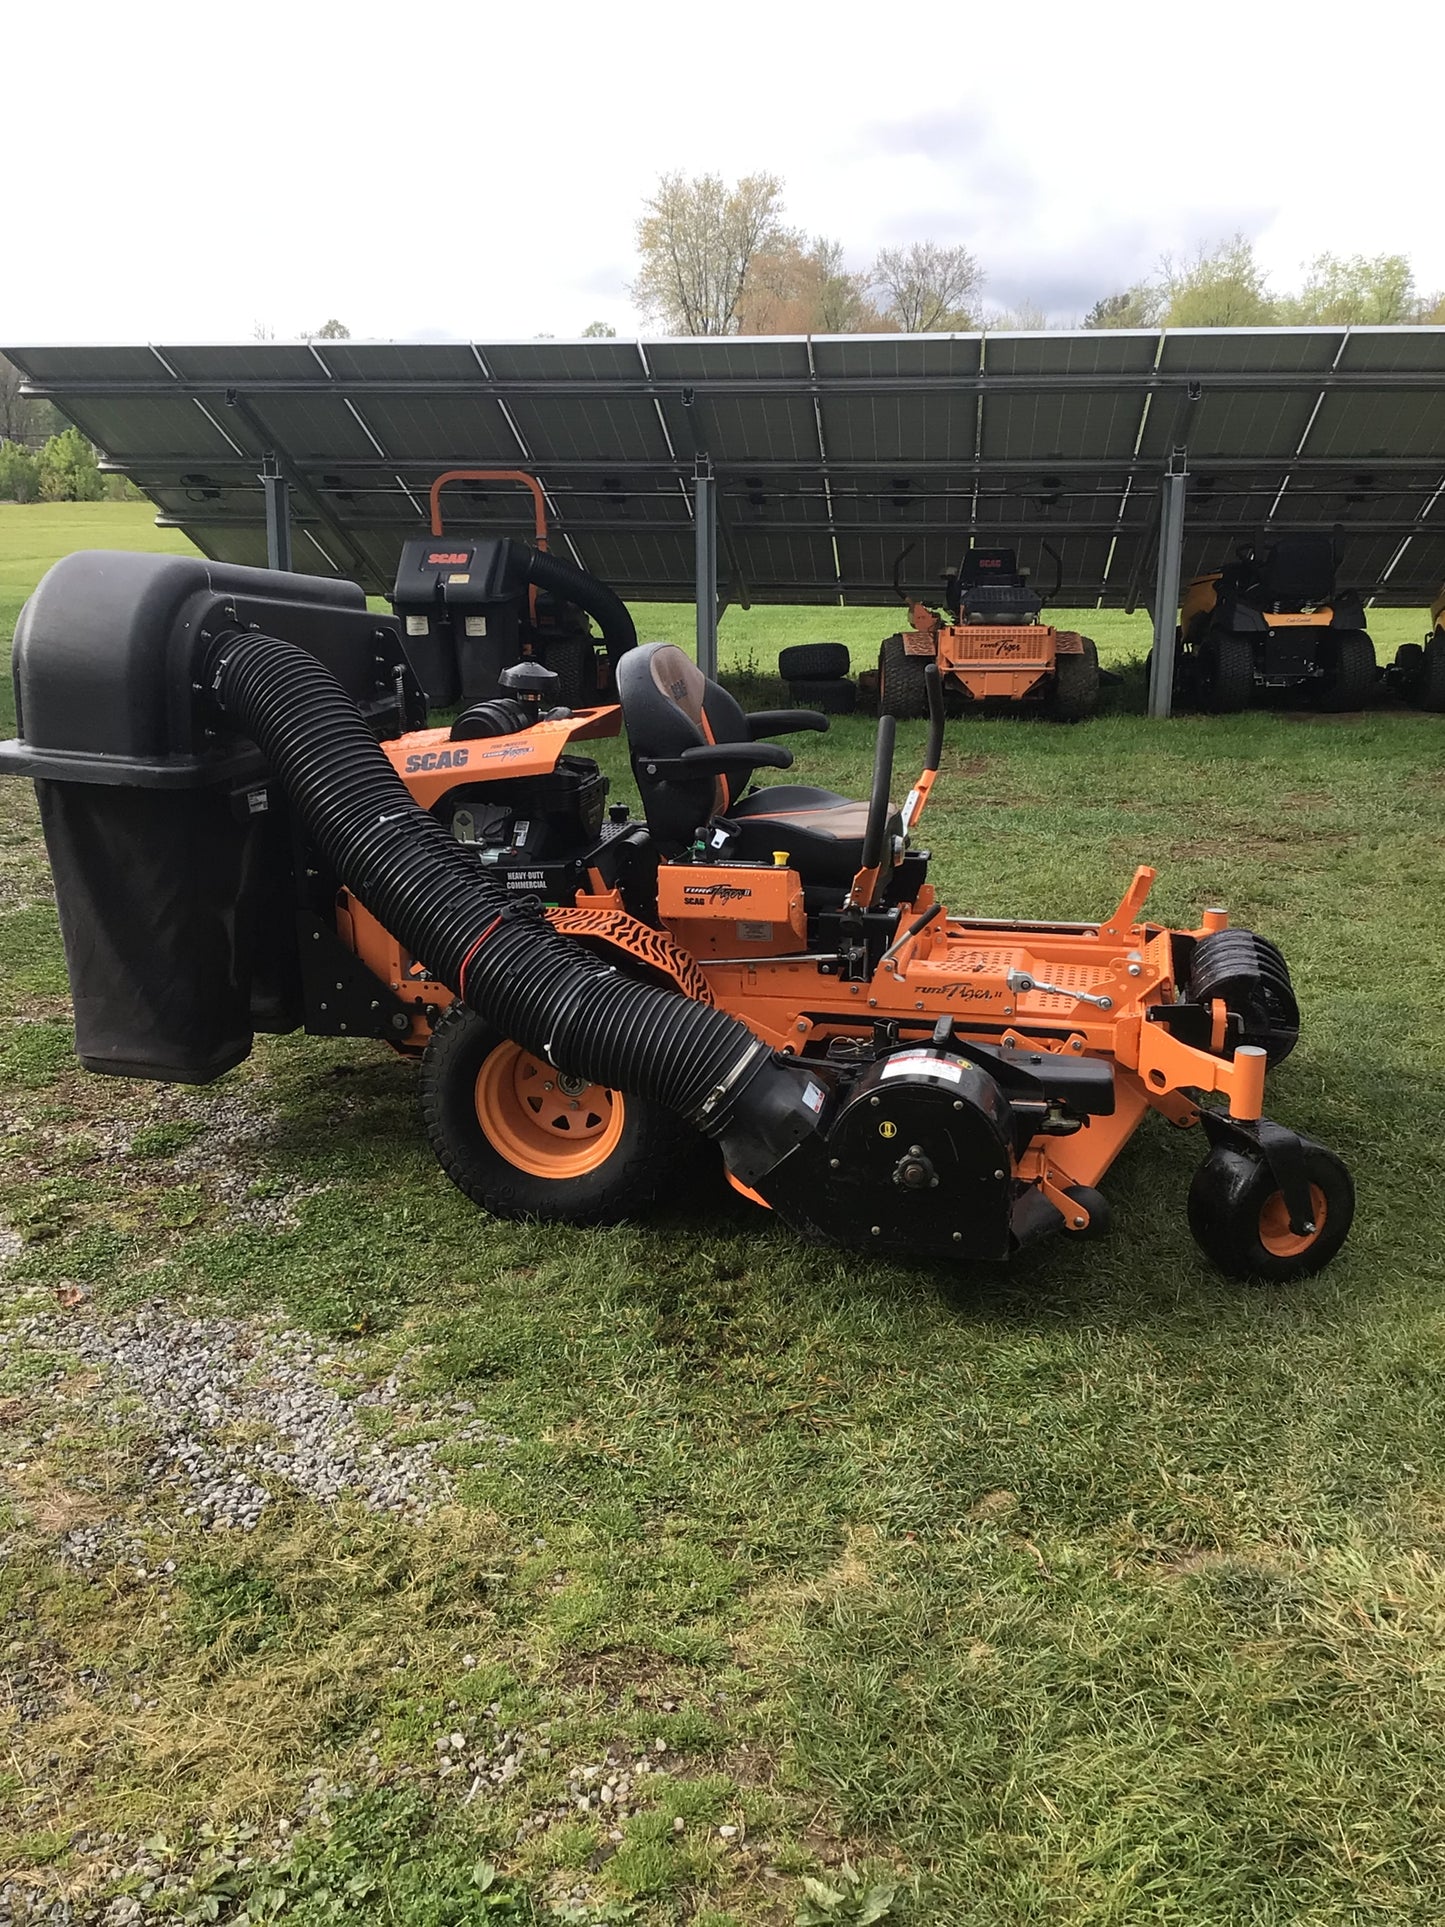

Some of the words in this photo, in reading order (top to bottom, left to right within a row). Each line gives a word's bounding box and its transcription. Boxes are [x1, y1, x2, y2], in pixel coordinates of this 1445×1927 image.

[427, 553, 468, 564] SCAG
[405, 748, 470, 774] SCAG
[507, 871, 526, 880] HEAVY
[527, 871, 544, 880] DUTY
[506, 880, 547, 889] COMMERCIAL
[707, 884, 743, 906] Tiger
[684, 897, 705, 906] SCAG
